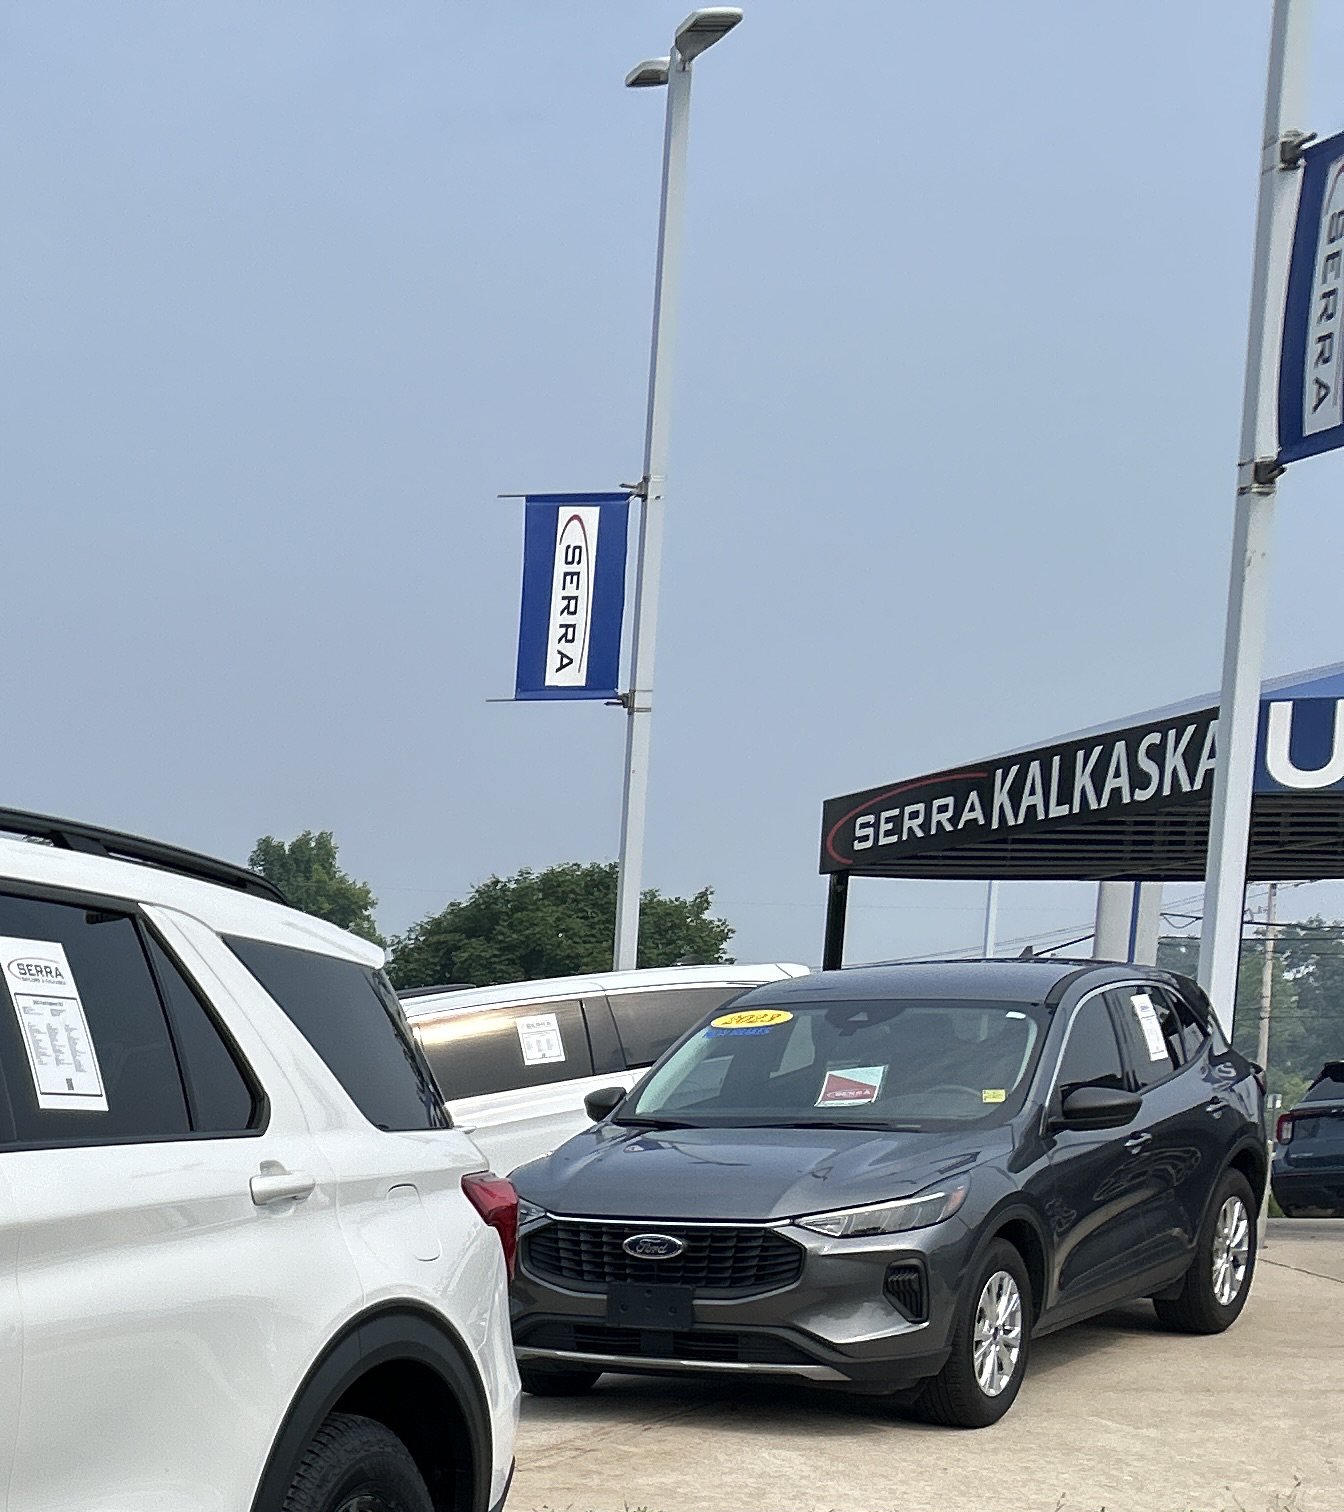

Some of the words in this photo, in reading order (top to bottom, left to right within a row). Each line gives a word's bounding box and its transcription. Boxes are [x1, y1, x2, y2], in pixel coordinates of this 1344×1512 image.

[555, 544, 582, 674] SERRA
[853, 791, 986, 851] SERRA
[16, 962, 65, 980] SERRA
[635, 1238, 669, 1254] Ford
